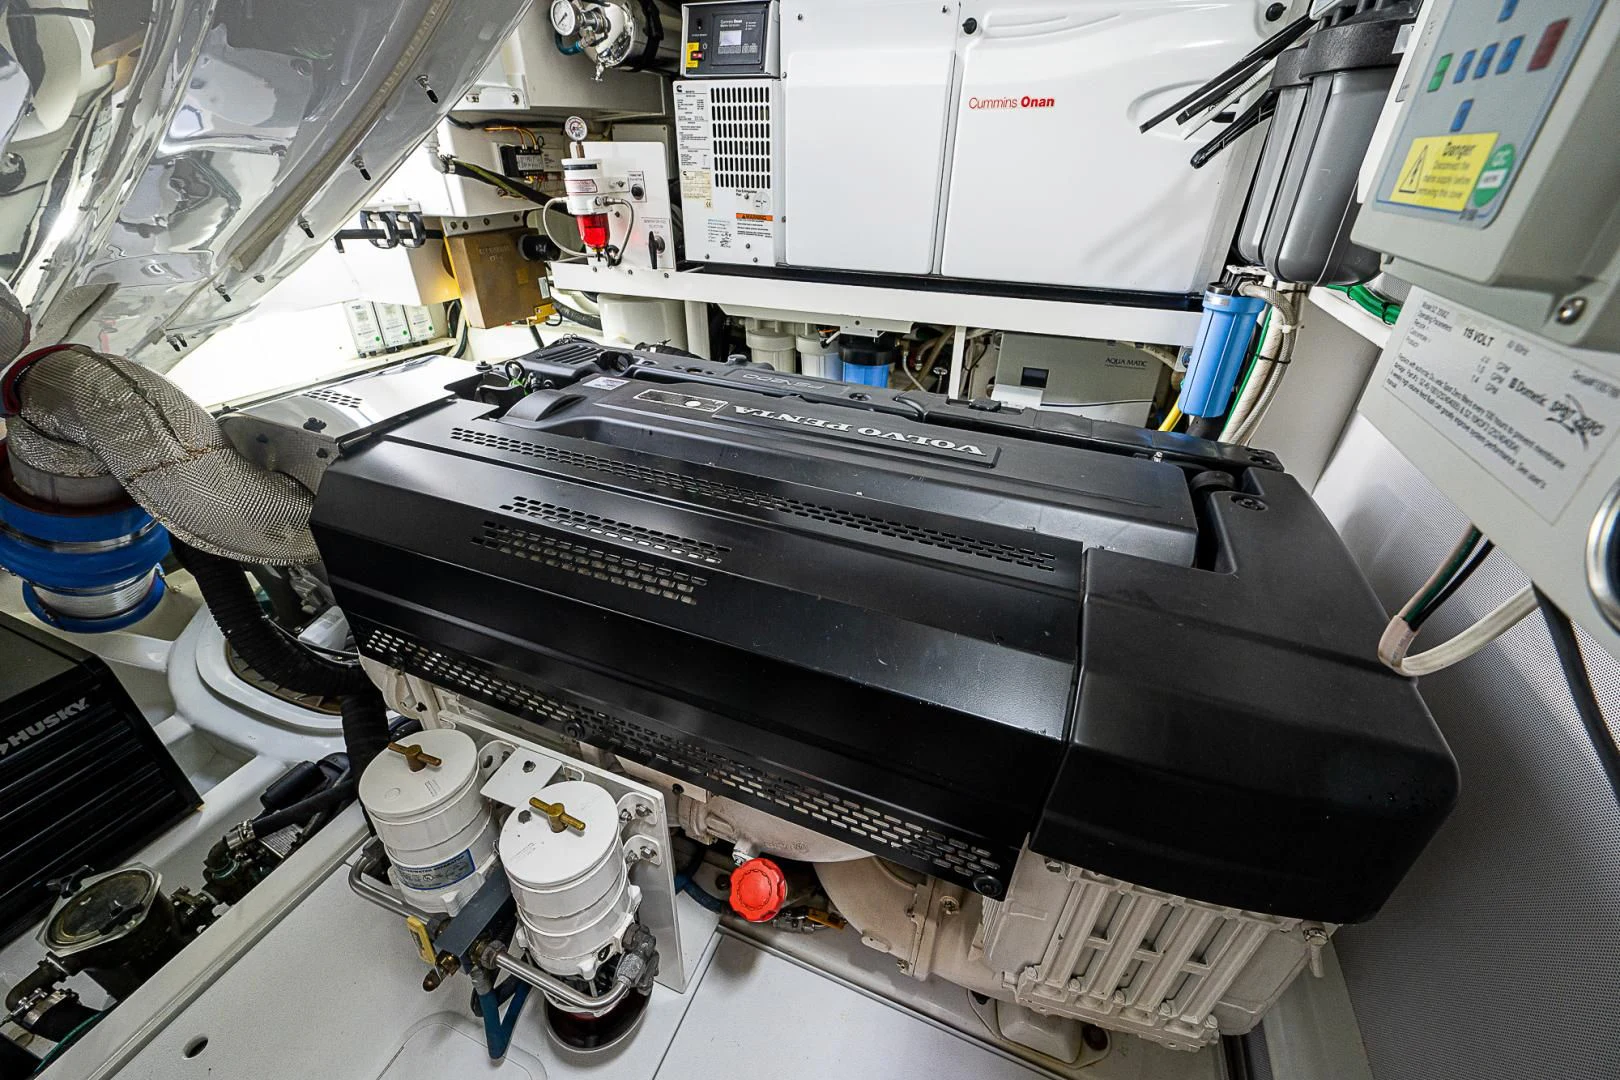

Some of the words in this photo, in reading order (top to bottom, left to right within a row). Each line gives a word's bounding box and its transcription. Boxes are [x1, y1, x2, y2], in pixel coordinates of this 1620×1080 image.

[968, 97, 1018, 109] Cummins
[1020, 96, 1055, 107] Onan
[1442, 141, 1476, 160] Danger
[1463, 327, 1475, 339] 115
[1473, 332, 1494, 347] VOLT
[1105, 358, 1126, 366] AQUA
[1490, 372, 1505, 384] GPM
[1515, 381, 1547, 406] Dometic
[732, 405, 852, 432] PENTA
[1472, 403, 1485, 415] every
[1494, 416, 1508, 430] hours
[1512, 431, 1535, 448] prevent
[858, 427, 988, 457] VOLVO
[1516, 462, 1529, 475] See
[7, 697, 86, 747] HUSKY
